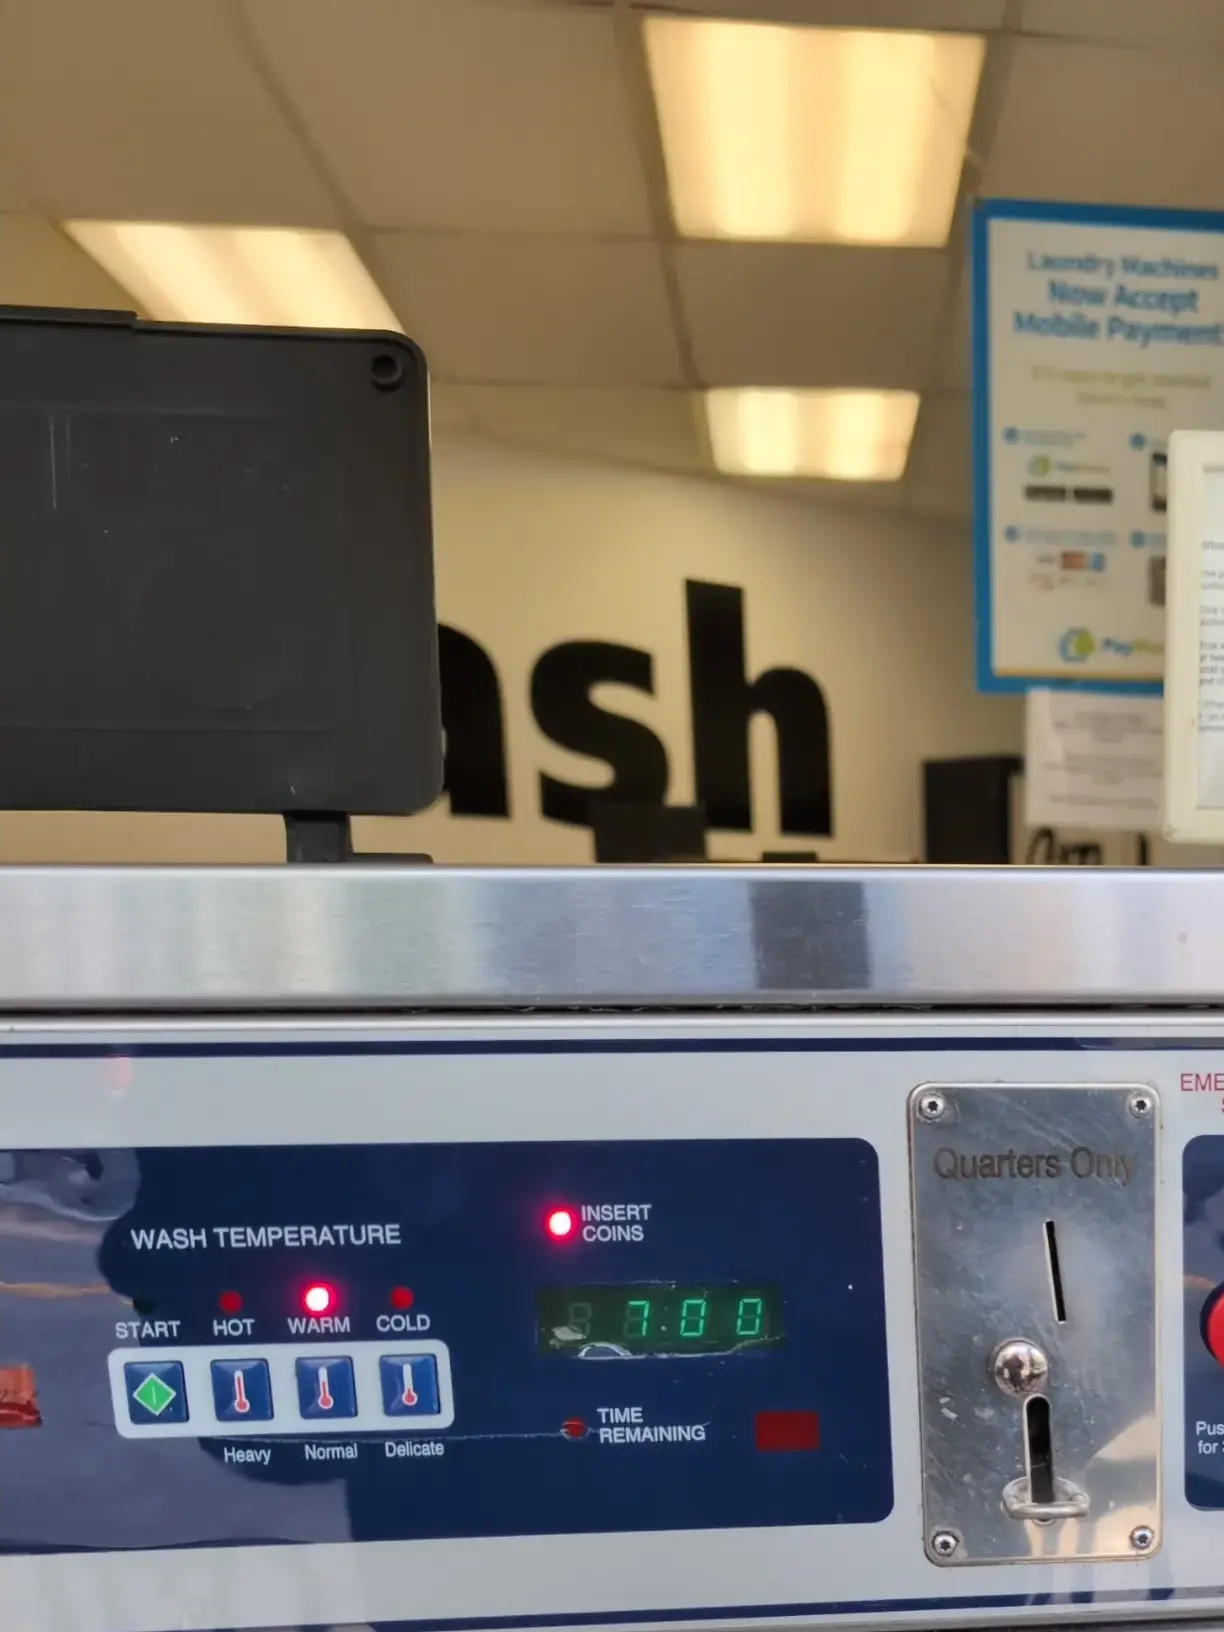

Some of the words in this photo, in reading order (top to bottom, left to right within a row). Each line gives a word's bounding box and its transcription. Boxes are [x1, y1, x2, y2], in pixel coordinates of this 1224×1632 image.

[1048, 280, 1107, 305] Now
[1116, 284, 1197, 317] Accept
[1013, 310, 1100, 340] Mobile
[934, 1148, 1060, 1179] Quarters
[1071, 1146, 1136, 1185] Only
[581, 1204, 652, 1221] INSERT
[130, 1228, 206, 1250] WASH
[212, 1224, 402, 1248] TEMPERATURE
[582, 1225, 644, 1242] COINS
[115, 1320, 180, 1339] START
[213, 1319, 255, 1336] HOT
[288, 1317, 350, 1334] WARM
[376, 1314, 430, 1332] COLD
[597, 1406, 643, 1423] TIME
[599, 1424, 706, 1444] REMAINING
[1198, 1439, 1219, 1454] for
[223, 1446, 271, 1466] Heavy
[304, 1442, 358, 1461] Normal
[384, 1440, 445, 1458] Delicate
